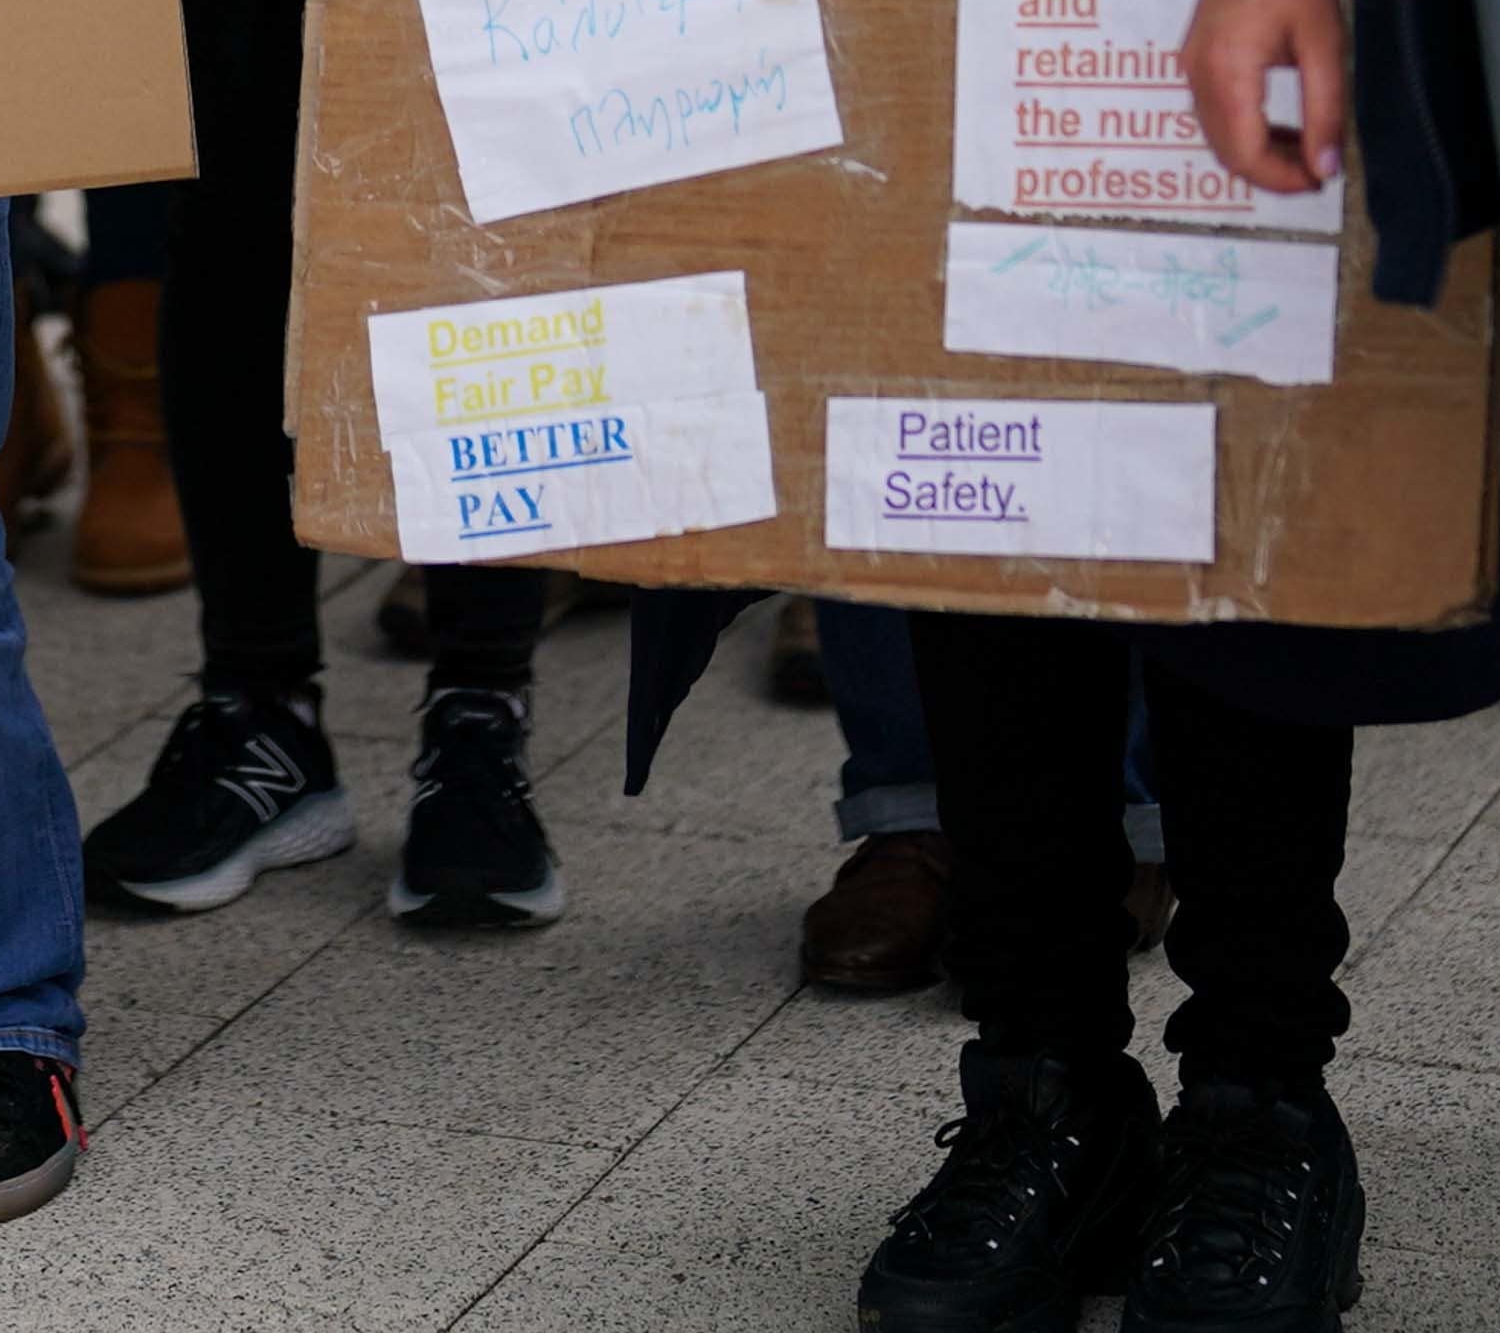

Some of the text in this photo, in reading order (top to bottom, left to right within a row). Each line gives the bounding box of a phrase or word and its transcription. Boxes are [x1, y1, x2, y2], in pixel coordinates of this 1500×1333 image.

[1015, 40, 1186, 79] retainin
[1014, 98, 1200, 139] the nurs
[1014, 159, 1254, 205] profession
[427, 295, 606, 359] Demand
[434, 361, 607, 415] Fair Pay
[448, 415, 631, 472] BETTER
[899, 411, 1043, 453] Patient
[456, 483, 546, 531] PAY
[884, 470, 1026, 521] Safety.
